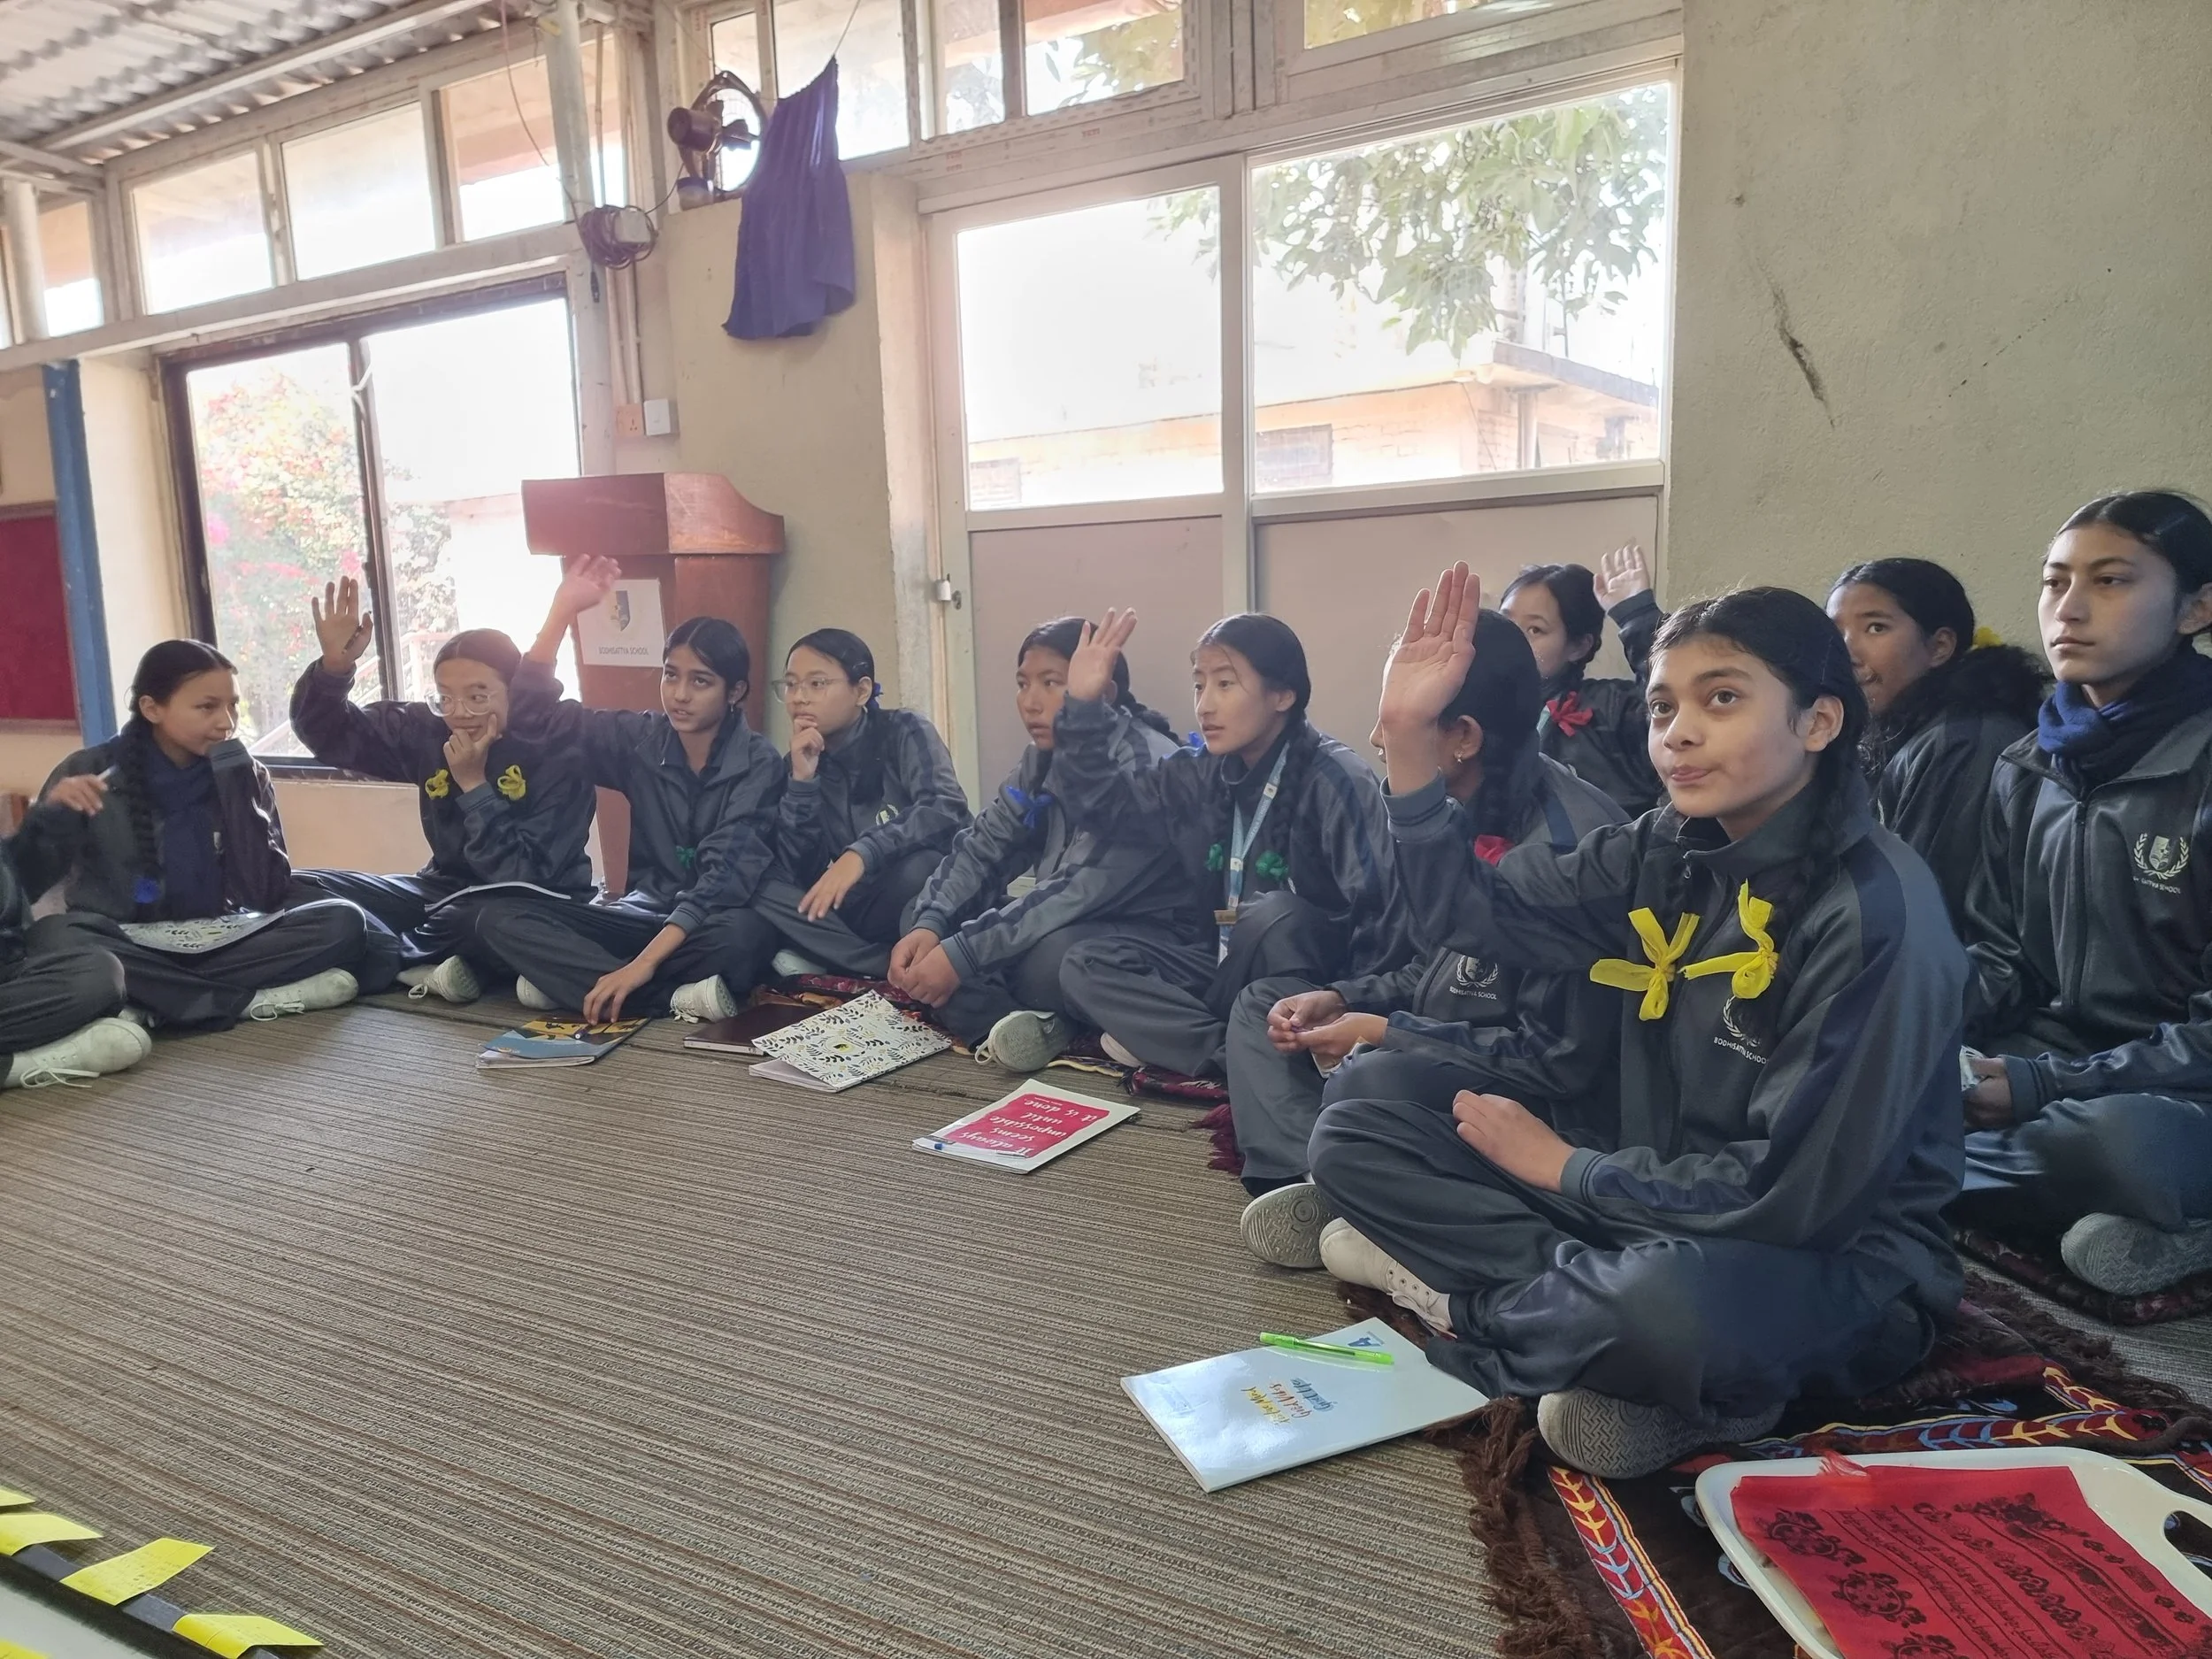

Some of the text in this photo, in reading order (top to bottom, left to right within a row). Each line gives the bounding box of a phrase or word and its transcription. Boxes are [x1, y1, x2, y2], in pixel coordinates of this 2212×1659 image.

[630, 647, 649, 656] SCHOOL
[1478, 991, 1497, 1000] SCHOOL
[1746, 1051, 1769, 1064] SCHOO
[1020, 1111, 1063, 1125] until
[1064, 1109, 1079, 1118] is
[989, 1116, 1067, 1138] impossible
[958, 1132, 1013, 1148] always
[991, 1127, 1035, 1142] seems
[1016, 1146, 1034, 1156] It
